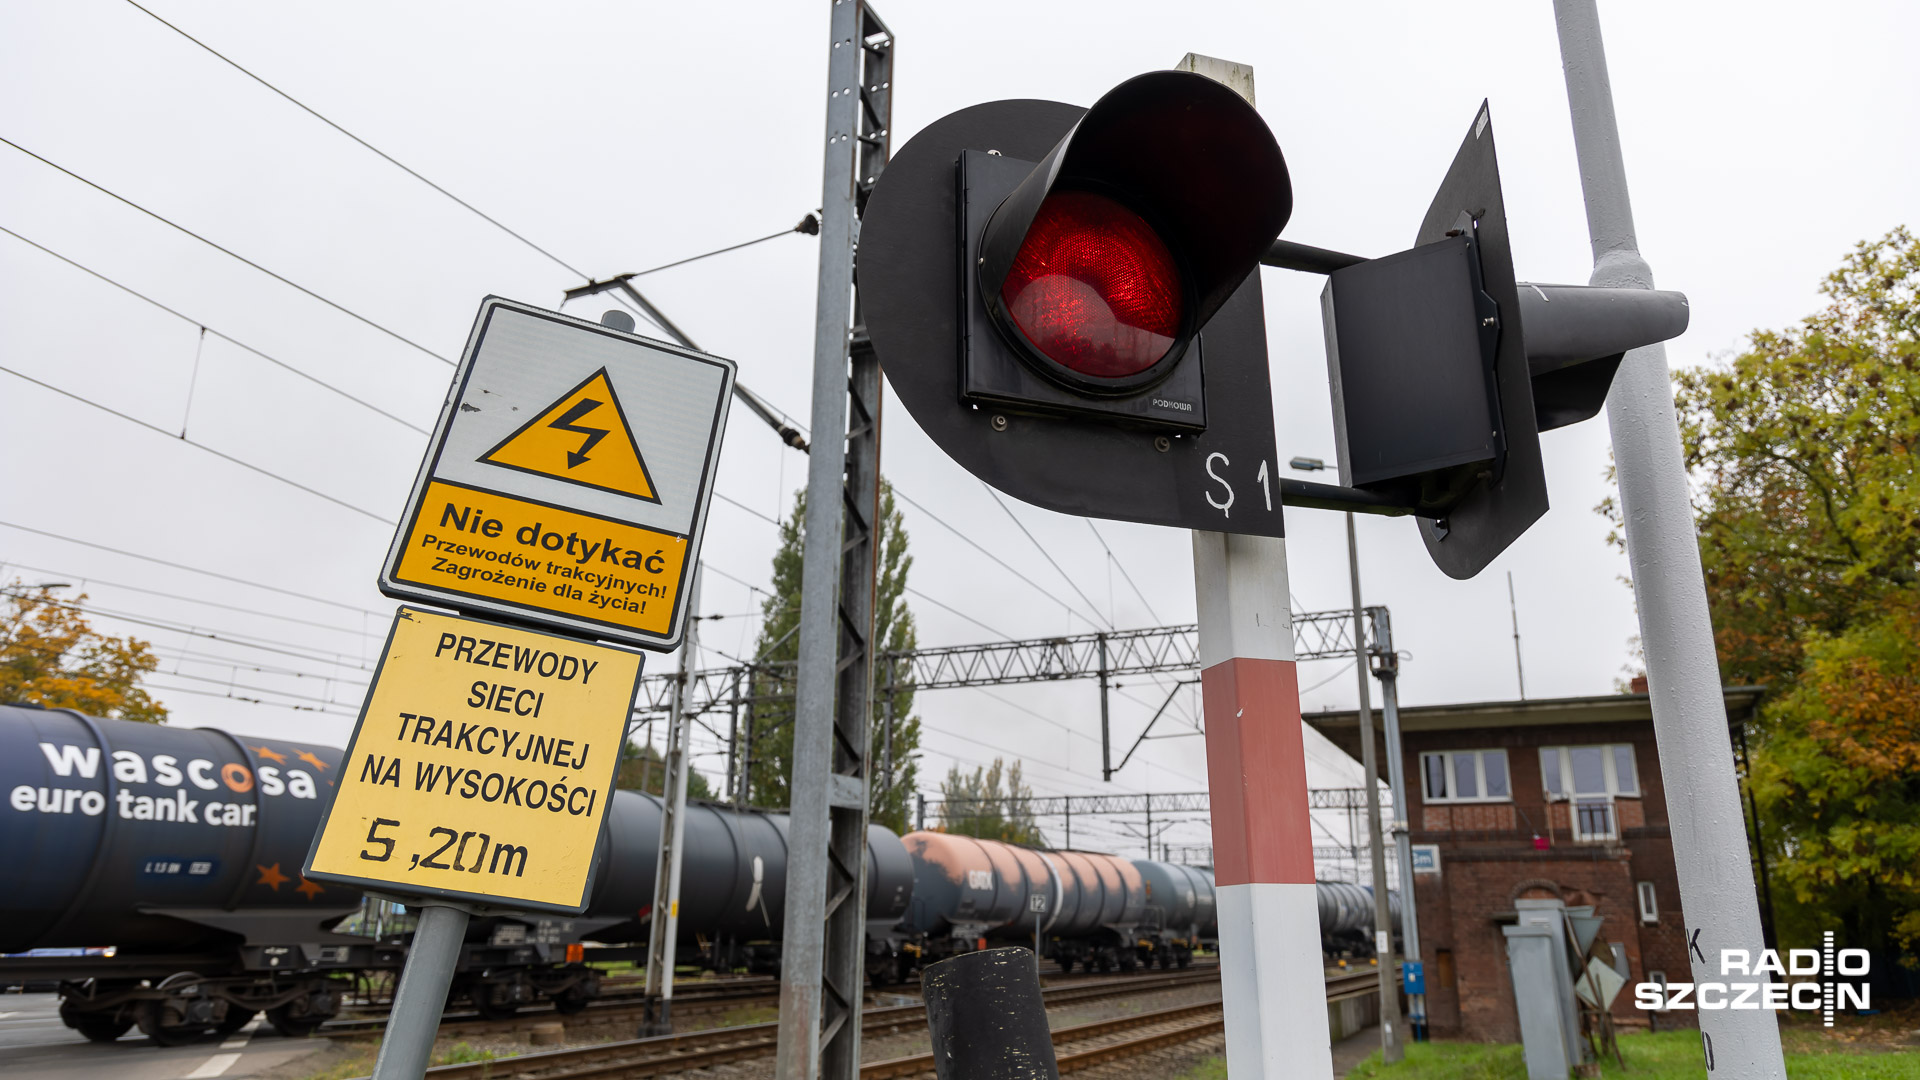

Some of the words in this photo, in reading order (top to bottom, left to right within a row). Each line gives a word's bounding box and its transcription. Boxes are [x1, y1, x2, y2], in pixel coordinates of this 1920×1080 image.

[1152, 398, 1192, 412] PODKOWA
[1206, 452, 1234, 518] S
[1257, 460, 1271, 511] 1
[421, 534, 541, 571] Przewodów
[546, 560, 668, 599] trakcyjnych!
[439, 502, 503, 538] Nie
[516, 522, 666, 574] dotykać
[431, 557, 547, 593] Zagrożenie
[553, 583, 583, 601] dla
[588, 590, 648, 615] życia!
[435, 632, 599, 685] PRZEWODY
[467, 681, 545, 718] SIECI
[397, 712, 590, 771] TRAKCYJNEJ
[39, 742, 317, 800] wascosa
[360, 754, 401, 788] NA
[414, 762, 597, 817] WYSOKOŚCI
[10, 785, 106, 816] euro
[117, 789, 198, 823] tank
[1686, 928, 1706, 965] K
